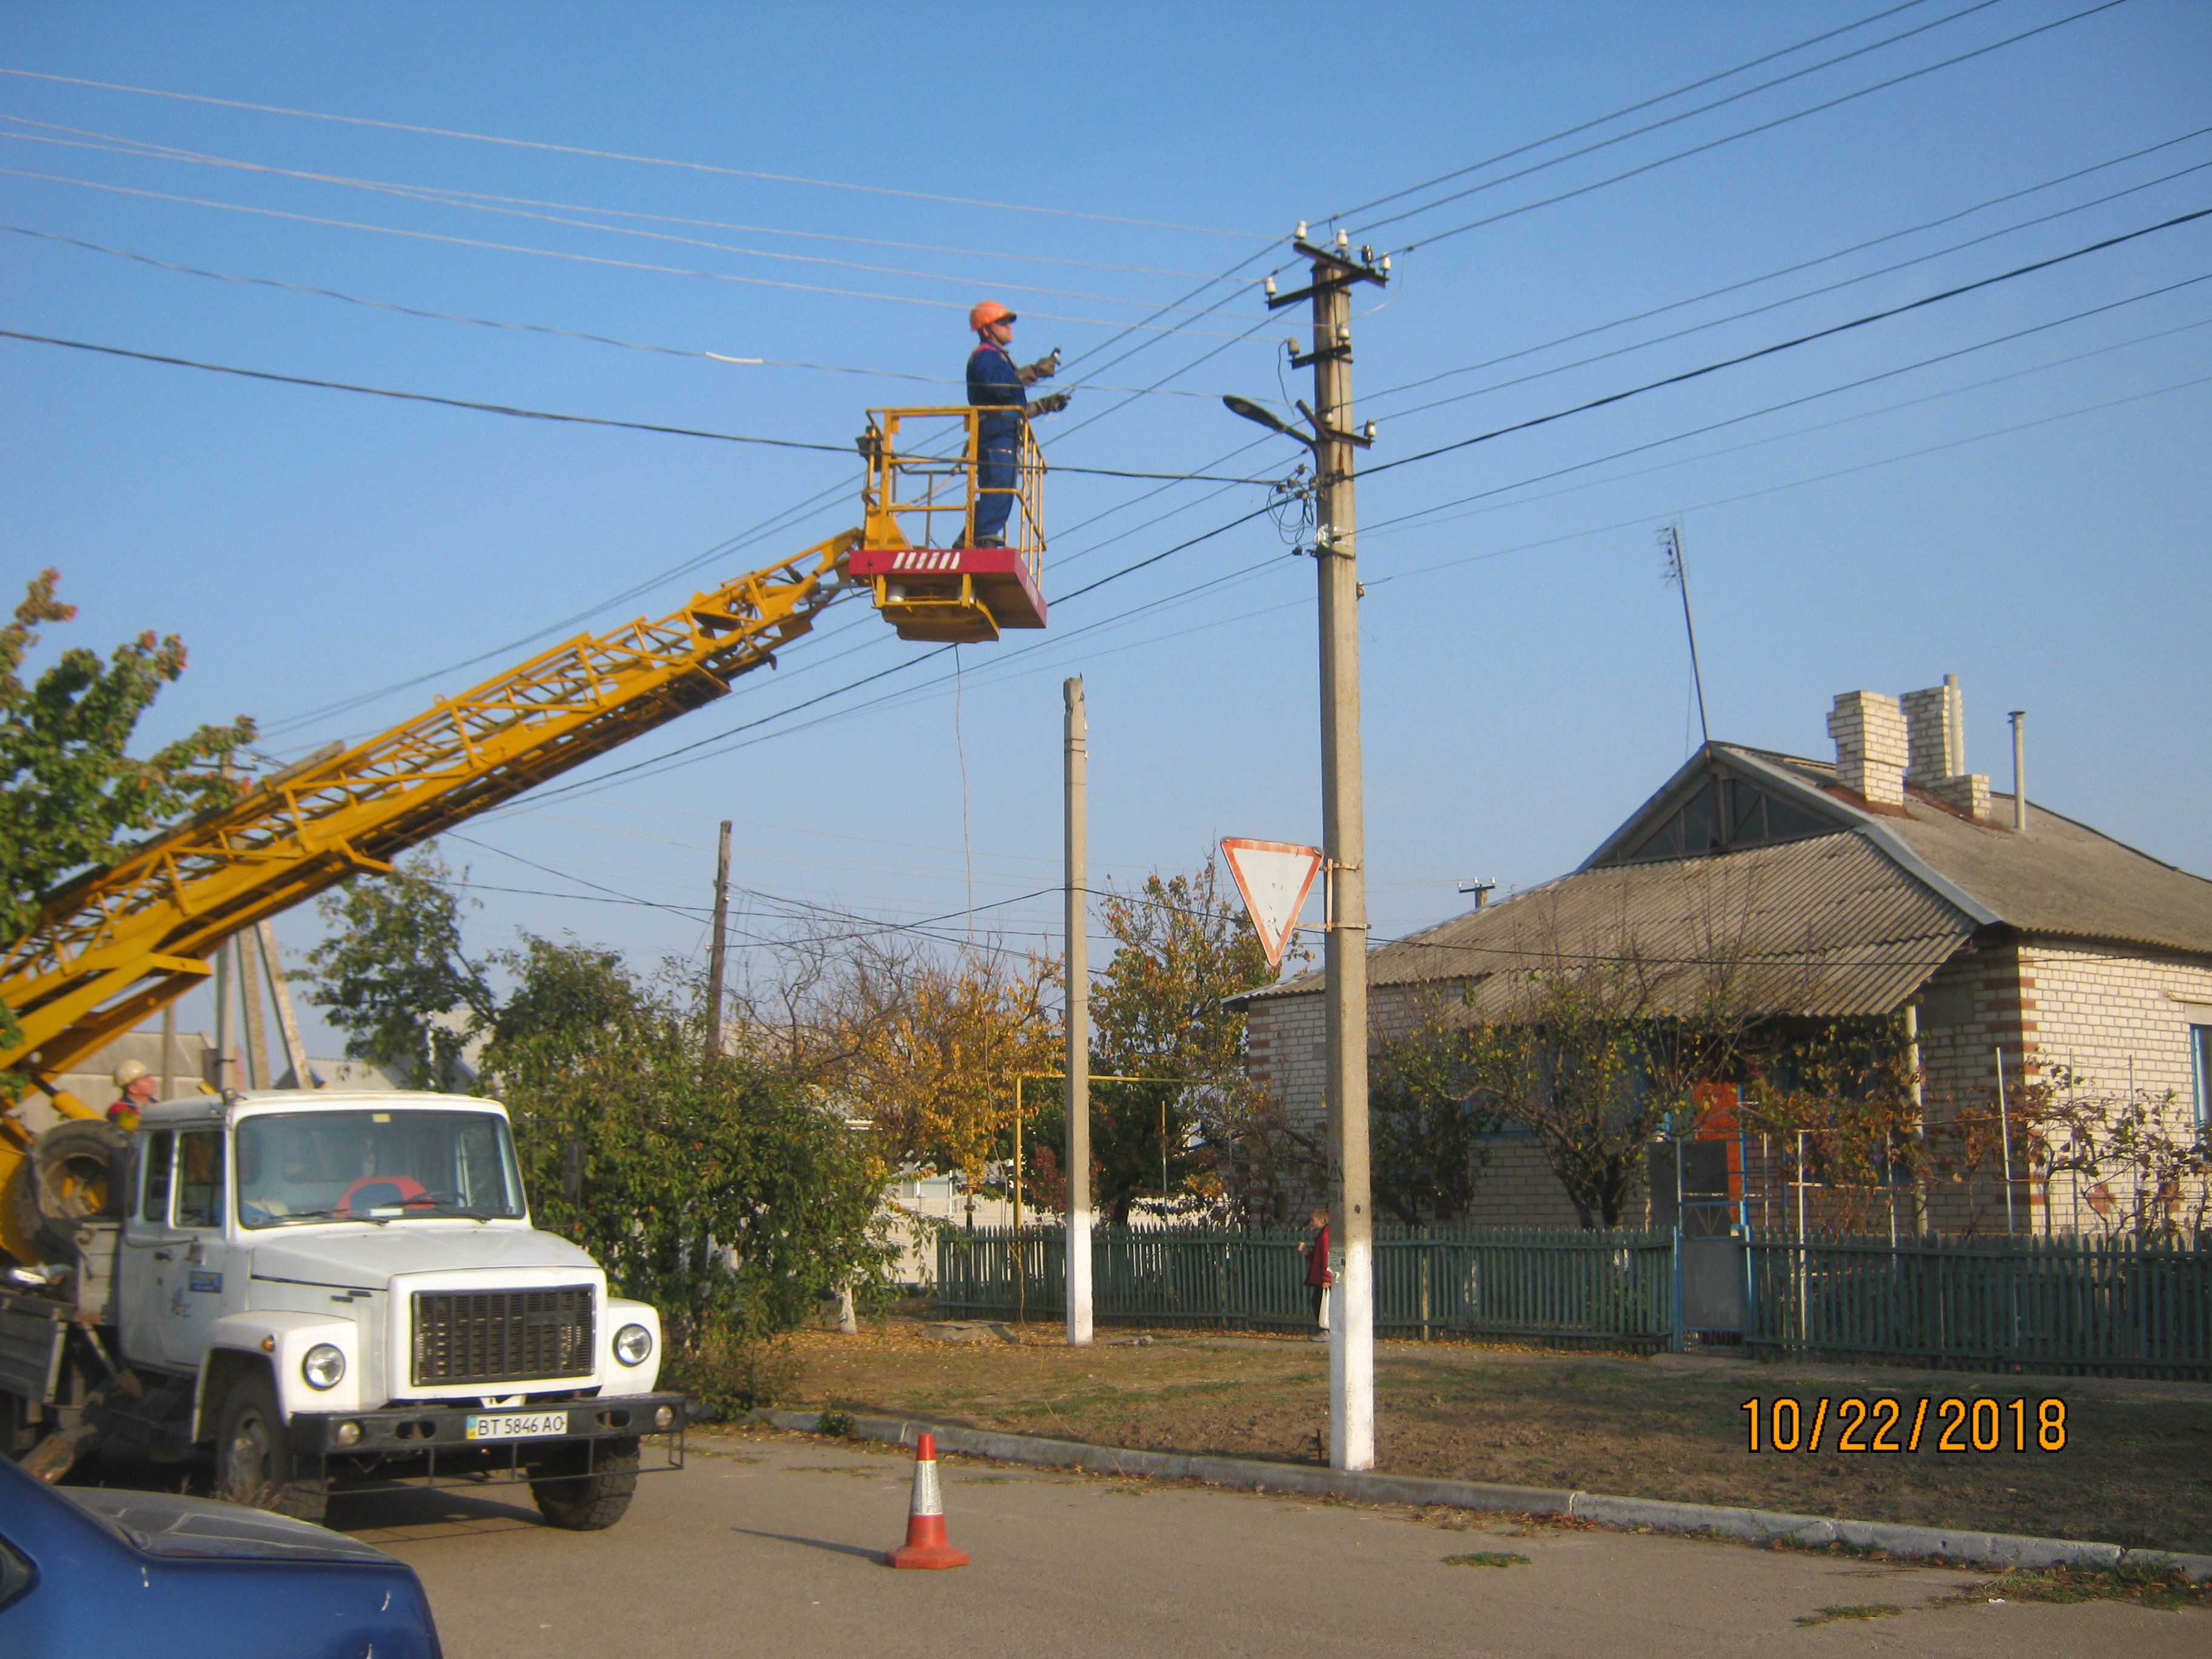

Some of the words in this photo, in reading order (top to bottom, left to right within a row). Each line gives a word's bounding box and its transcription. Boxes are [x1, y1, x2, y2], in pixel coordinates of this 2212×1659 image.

[478, 1419, 500, 1435] BT
[504, 1417, 538, 1434] 5846
[542, 1416, 564, 1432] AO
